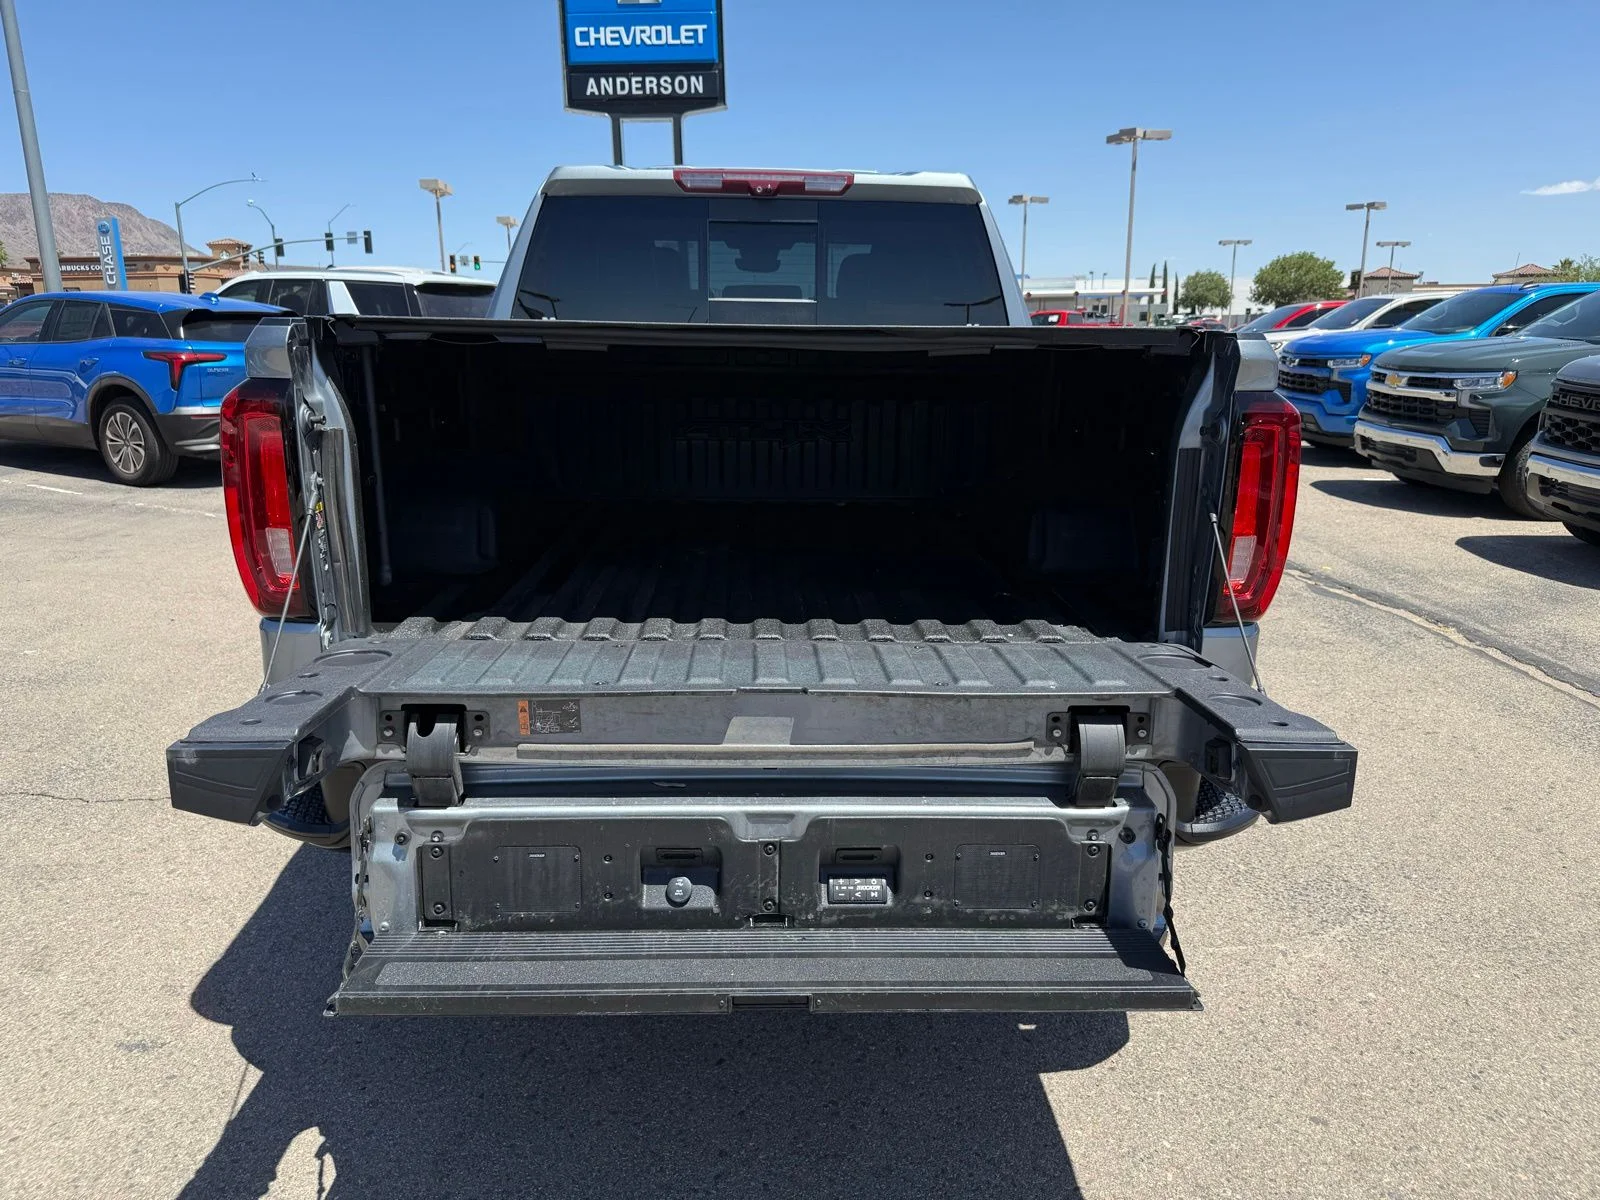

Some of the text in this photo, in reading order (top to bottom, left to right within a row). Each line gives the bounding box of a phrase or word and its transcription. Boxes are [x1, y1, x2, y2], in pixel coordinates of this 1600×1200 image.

[574, 24, 708, 47] CHEVROLET
[586, 75, 704, 96] ANDERSON
[100, 236, 117, 285] CHASE
